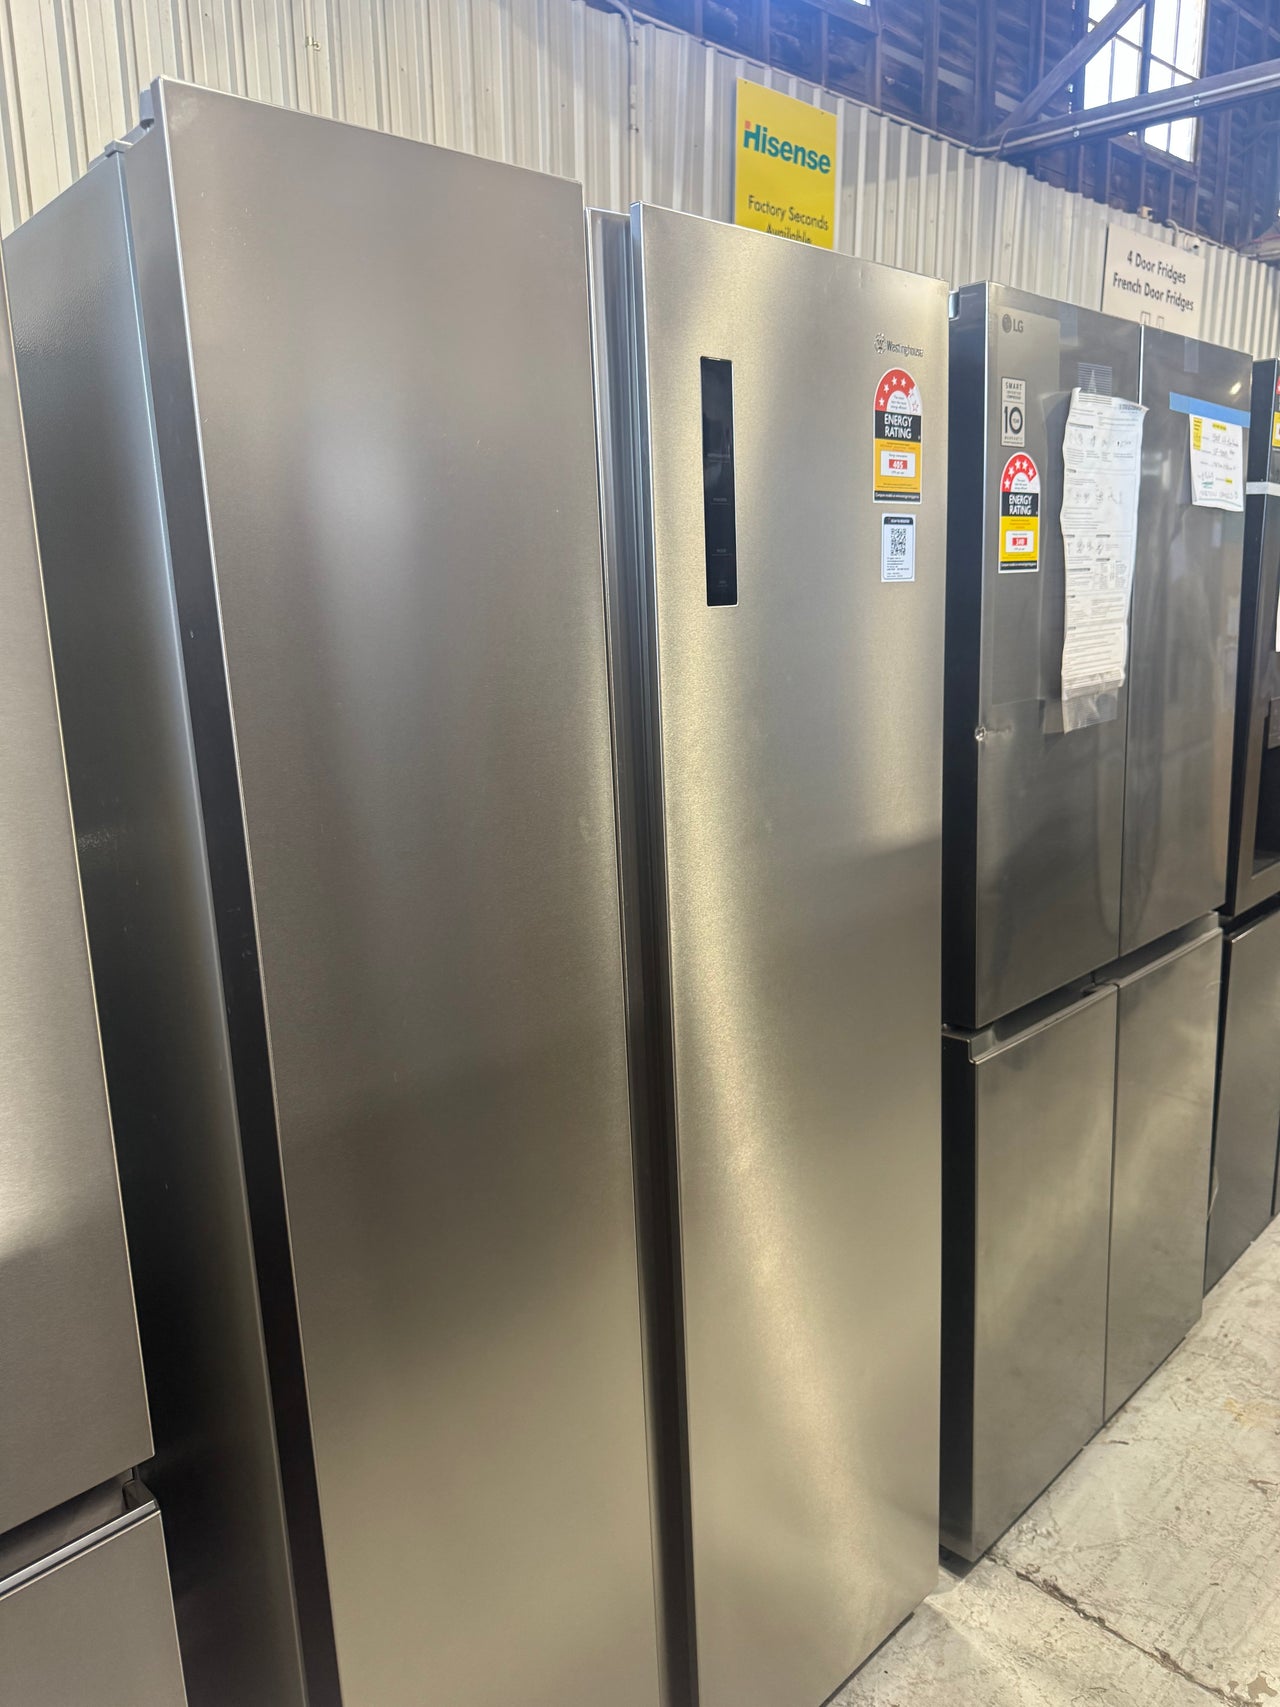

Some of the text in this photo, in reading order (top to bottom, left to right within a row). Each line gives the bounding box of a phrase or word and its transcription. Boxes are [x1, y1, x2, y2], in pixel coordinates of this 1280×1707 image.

[743, 120, 831, 174] Hisense
[748, 194, 829, 231] Factory Seconds
[1127, 250, 1186, 285] 4 Door Fridges
[1113, 272, 1194, 312] French Door Fridges
[1013, 318, 1024, 333] LG
[1005, 381, 1022, 391] SMART
[884, 413, 912, 427] ENERGY
[1004, 405, 1023, 435] 10
[884, 426, 912, 439] RATING
[1008, 494, 1033, 506] ENERGY
[1009, 505, 1032, 516] RATING
